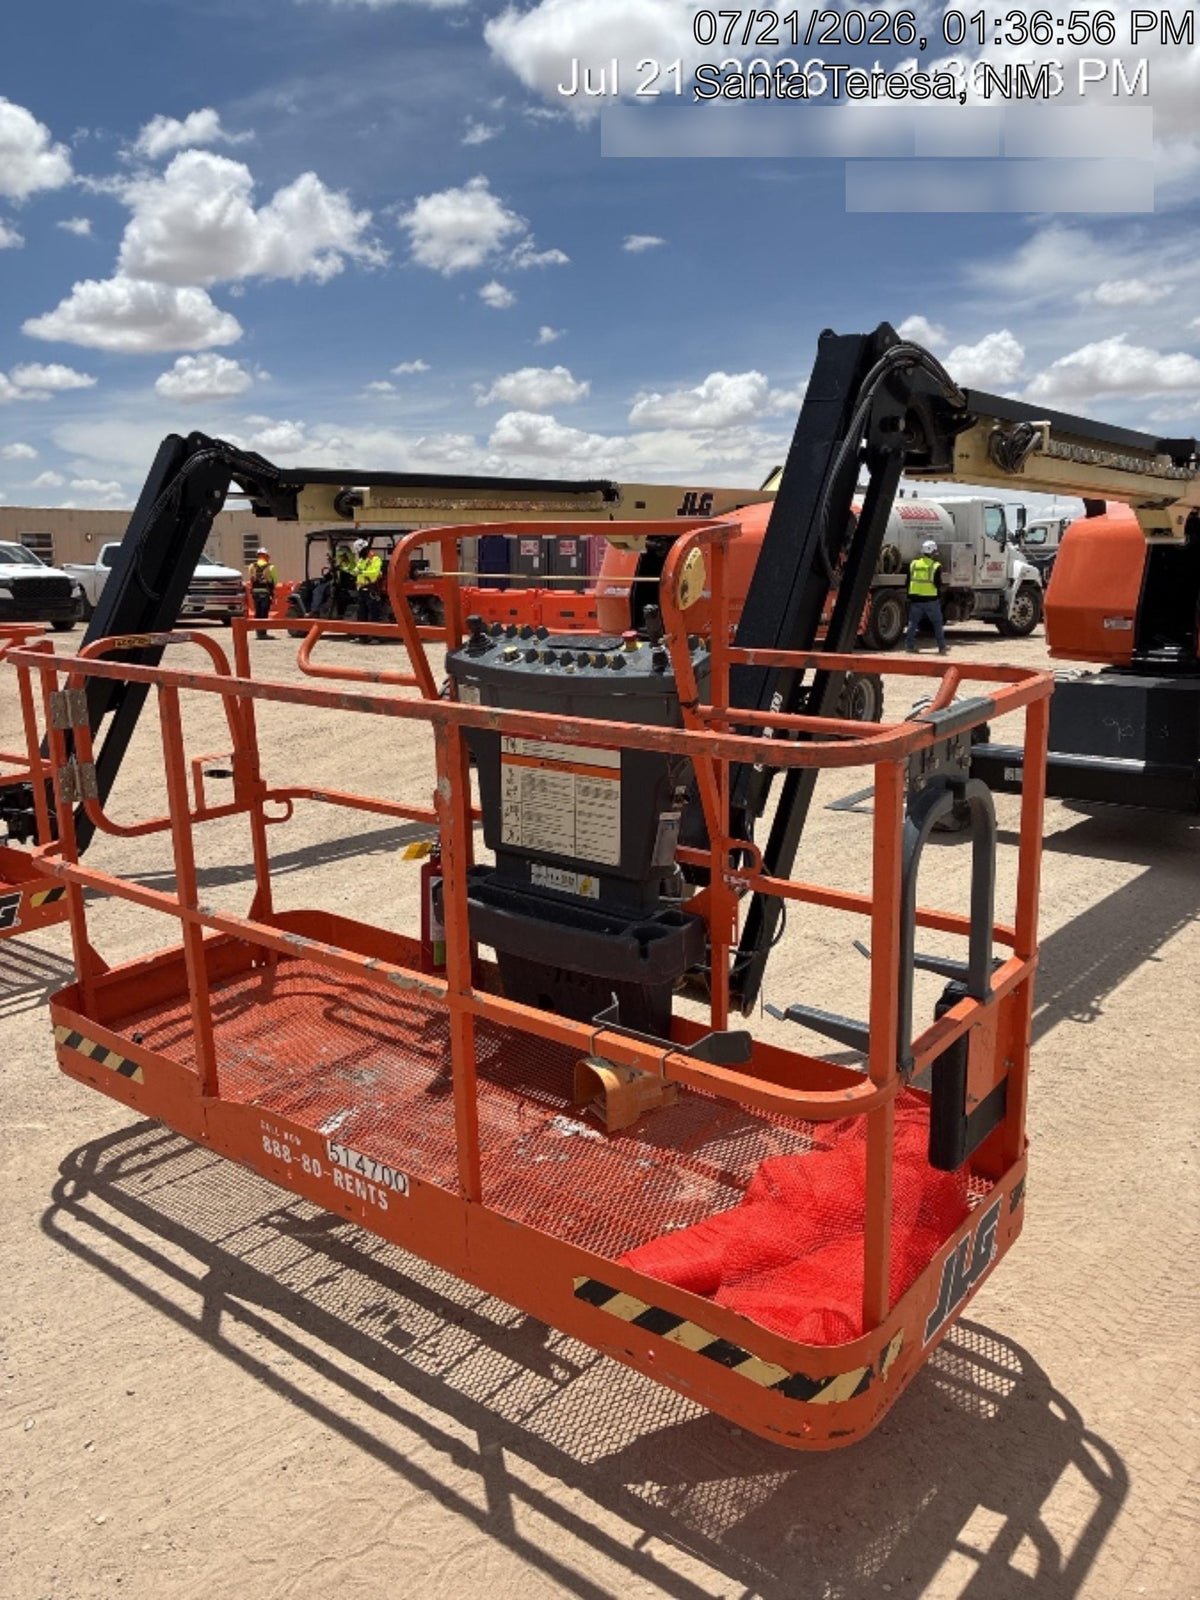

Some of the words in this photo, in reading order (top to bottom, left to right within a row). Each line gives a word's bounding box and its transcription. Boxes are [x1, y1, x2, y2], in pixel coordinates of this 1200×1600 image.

[676, 491, 714, 517] JLG
[262, 1135, 389, 1211] 888-80-RENTS
[921, 1193, 1003, 1351] JLG
